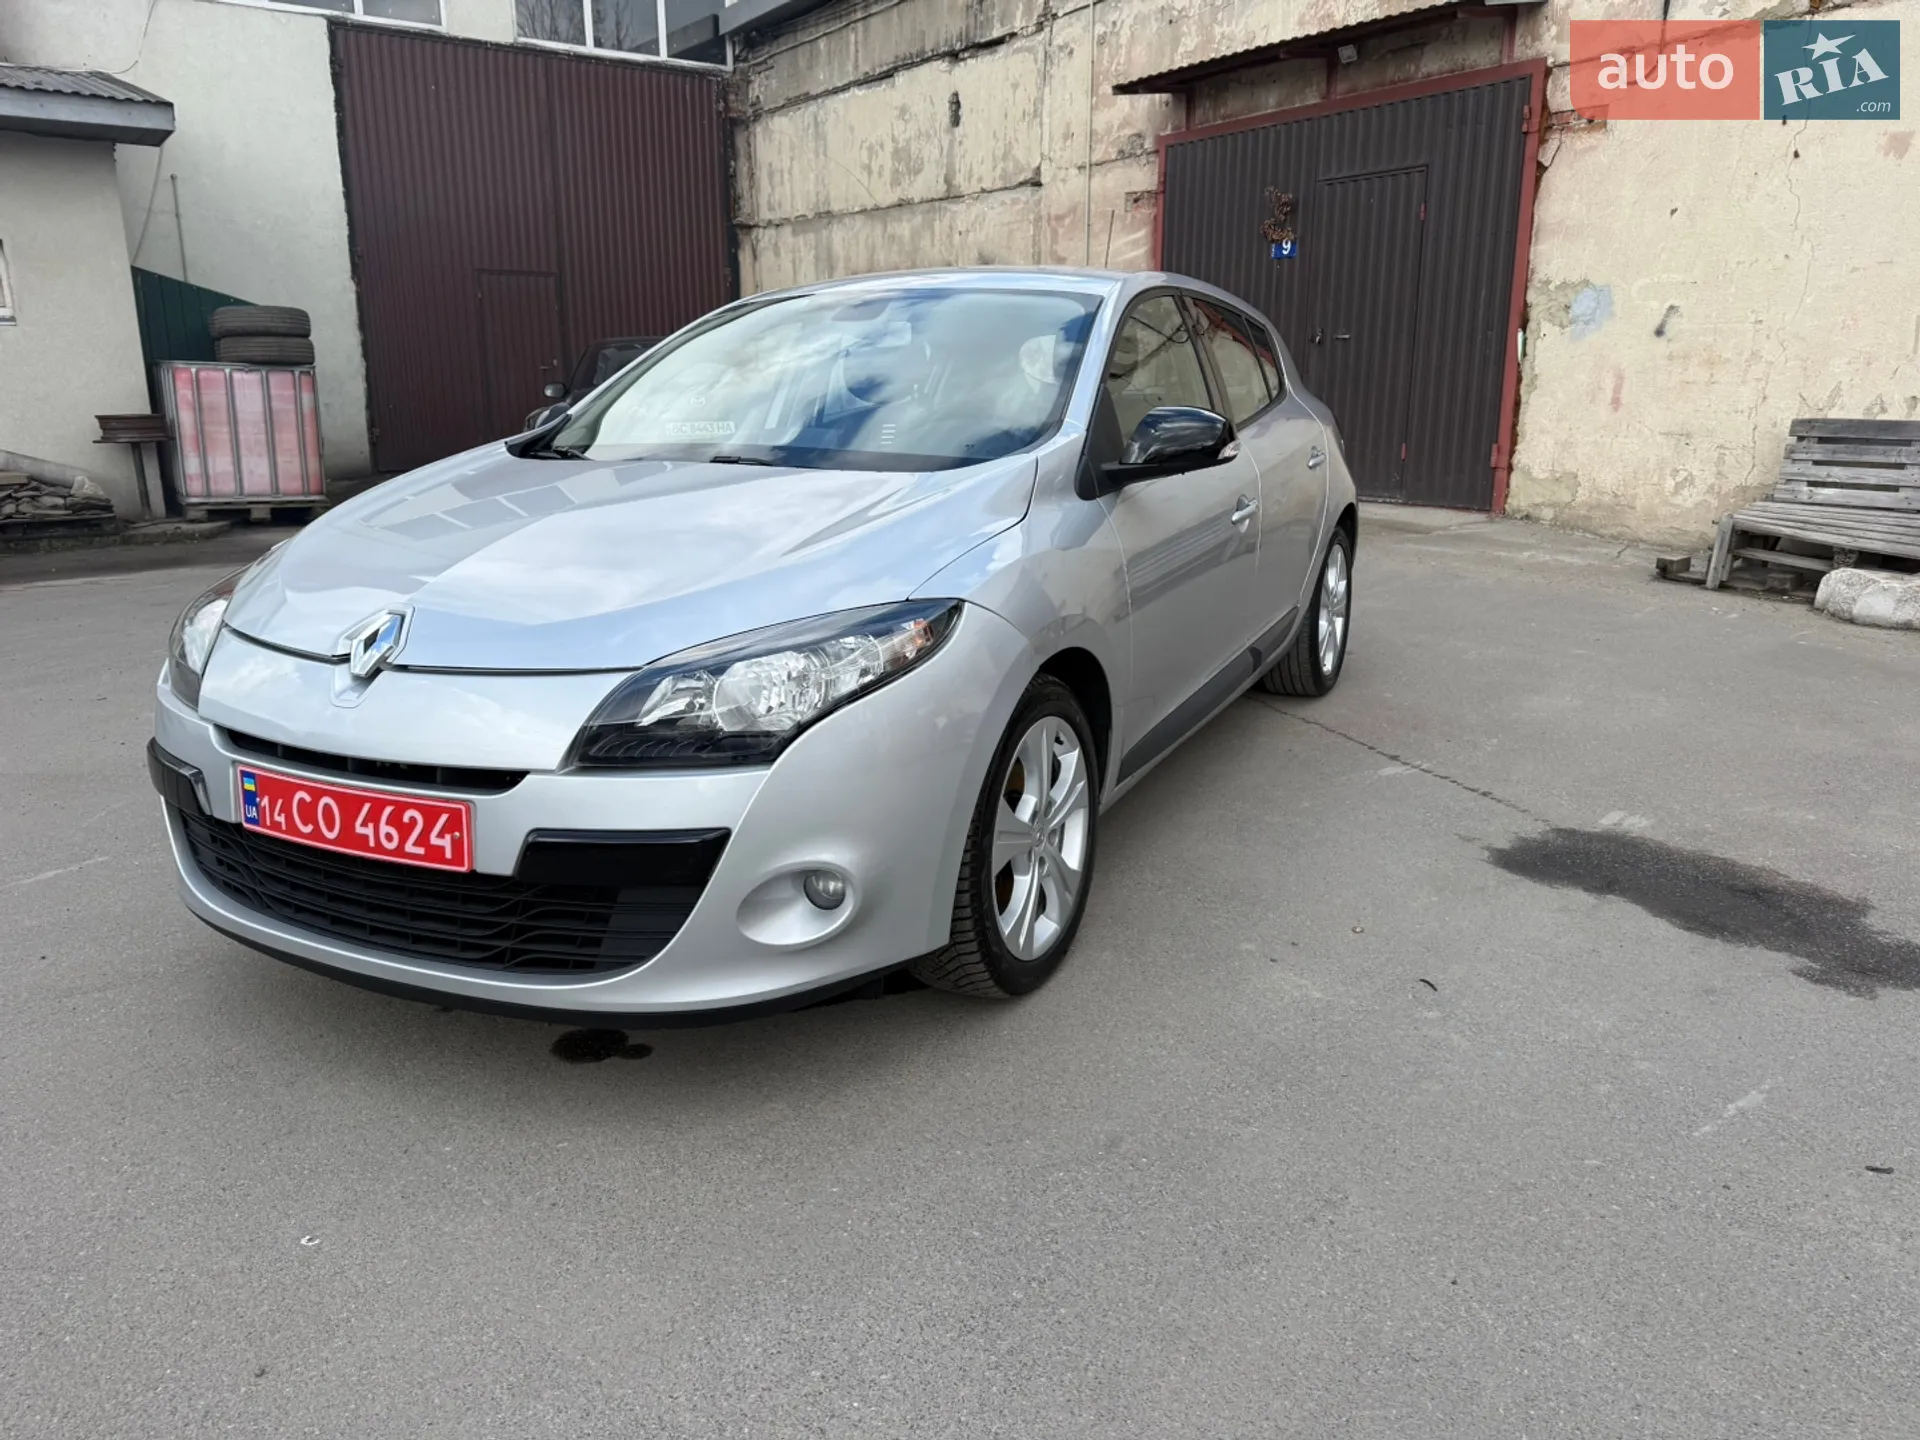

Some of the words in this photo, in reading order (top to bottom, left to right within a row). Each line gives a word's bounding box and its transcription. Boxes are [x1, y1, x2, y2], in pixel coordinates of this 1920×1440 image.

[1282, 238, 1291, 255] 9
[245, 805, 258, 820] UA
[354, 802, 453, 860] 4624
